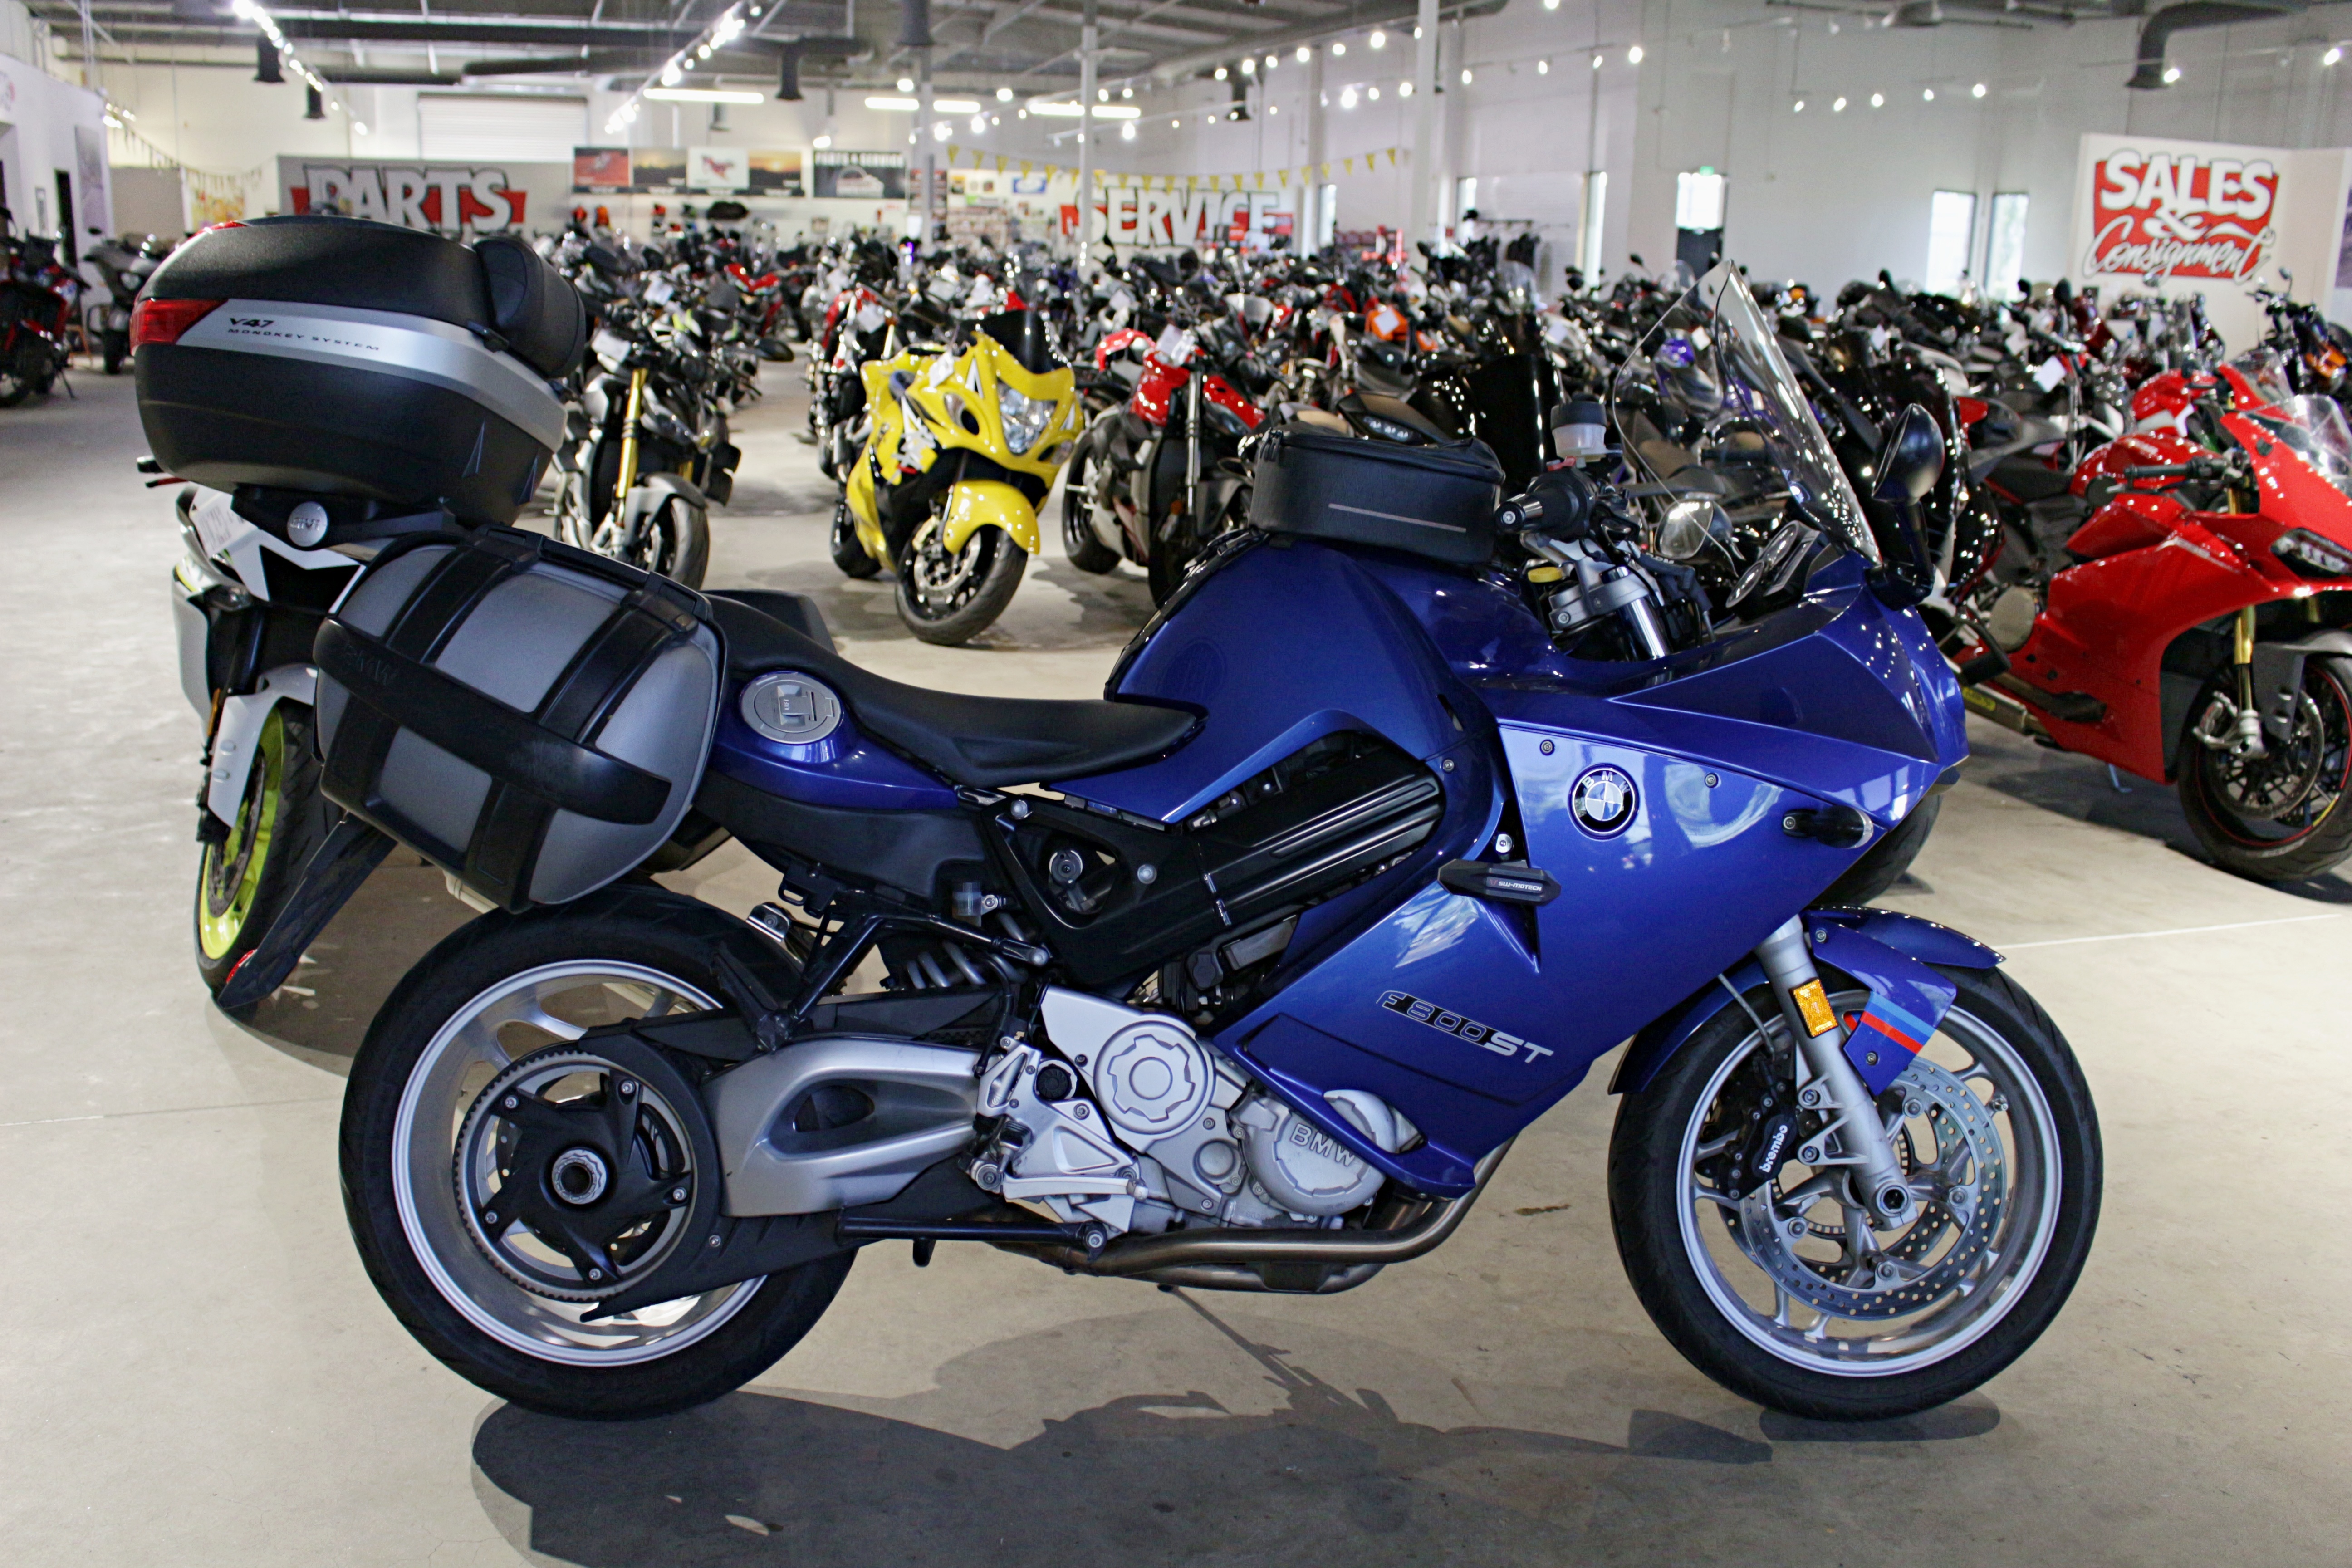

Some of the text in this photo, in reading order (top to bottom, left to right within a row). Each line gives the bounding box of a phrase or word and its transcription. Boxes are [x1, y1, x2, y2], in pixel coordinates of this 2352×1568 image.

[303, 164, 513, 233] PARTS
[2100, 148, 2274, 220] SALES
[1075, 186, 1280, 247] SERVICE
[2142, 206, 2207, 242] &
[2082, 214, 2277, 285] Consignment
[228, 328, 380, 351] MONOKEY SYSTEM
[229, 318, 274, 328] V47
[1582, 770, 1631, 794] BMW
[1290, 1122, 1356, 1167] BMW
[1759, 1124, 1788, 1173] brembo
